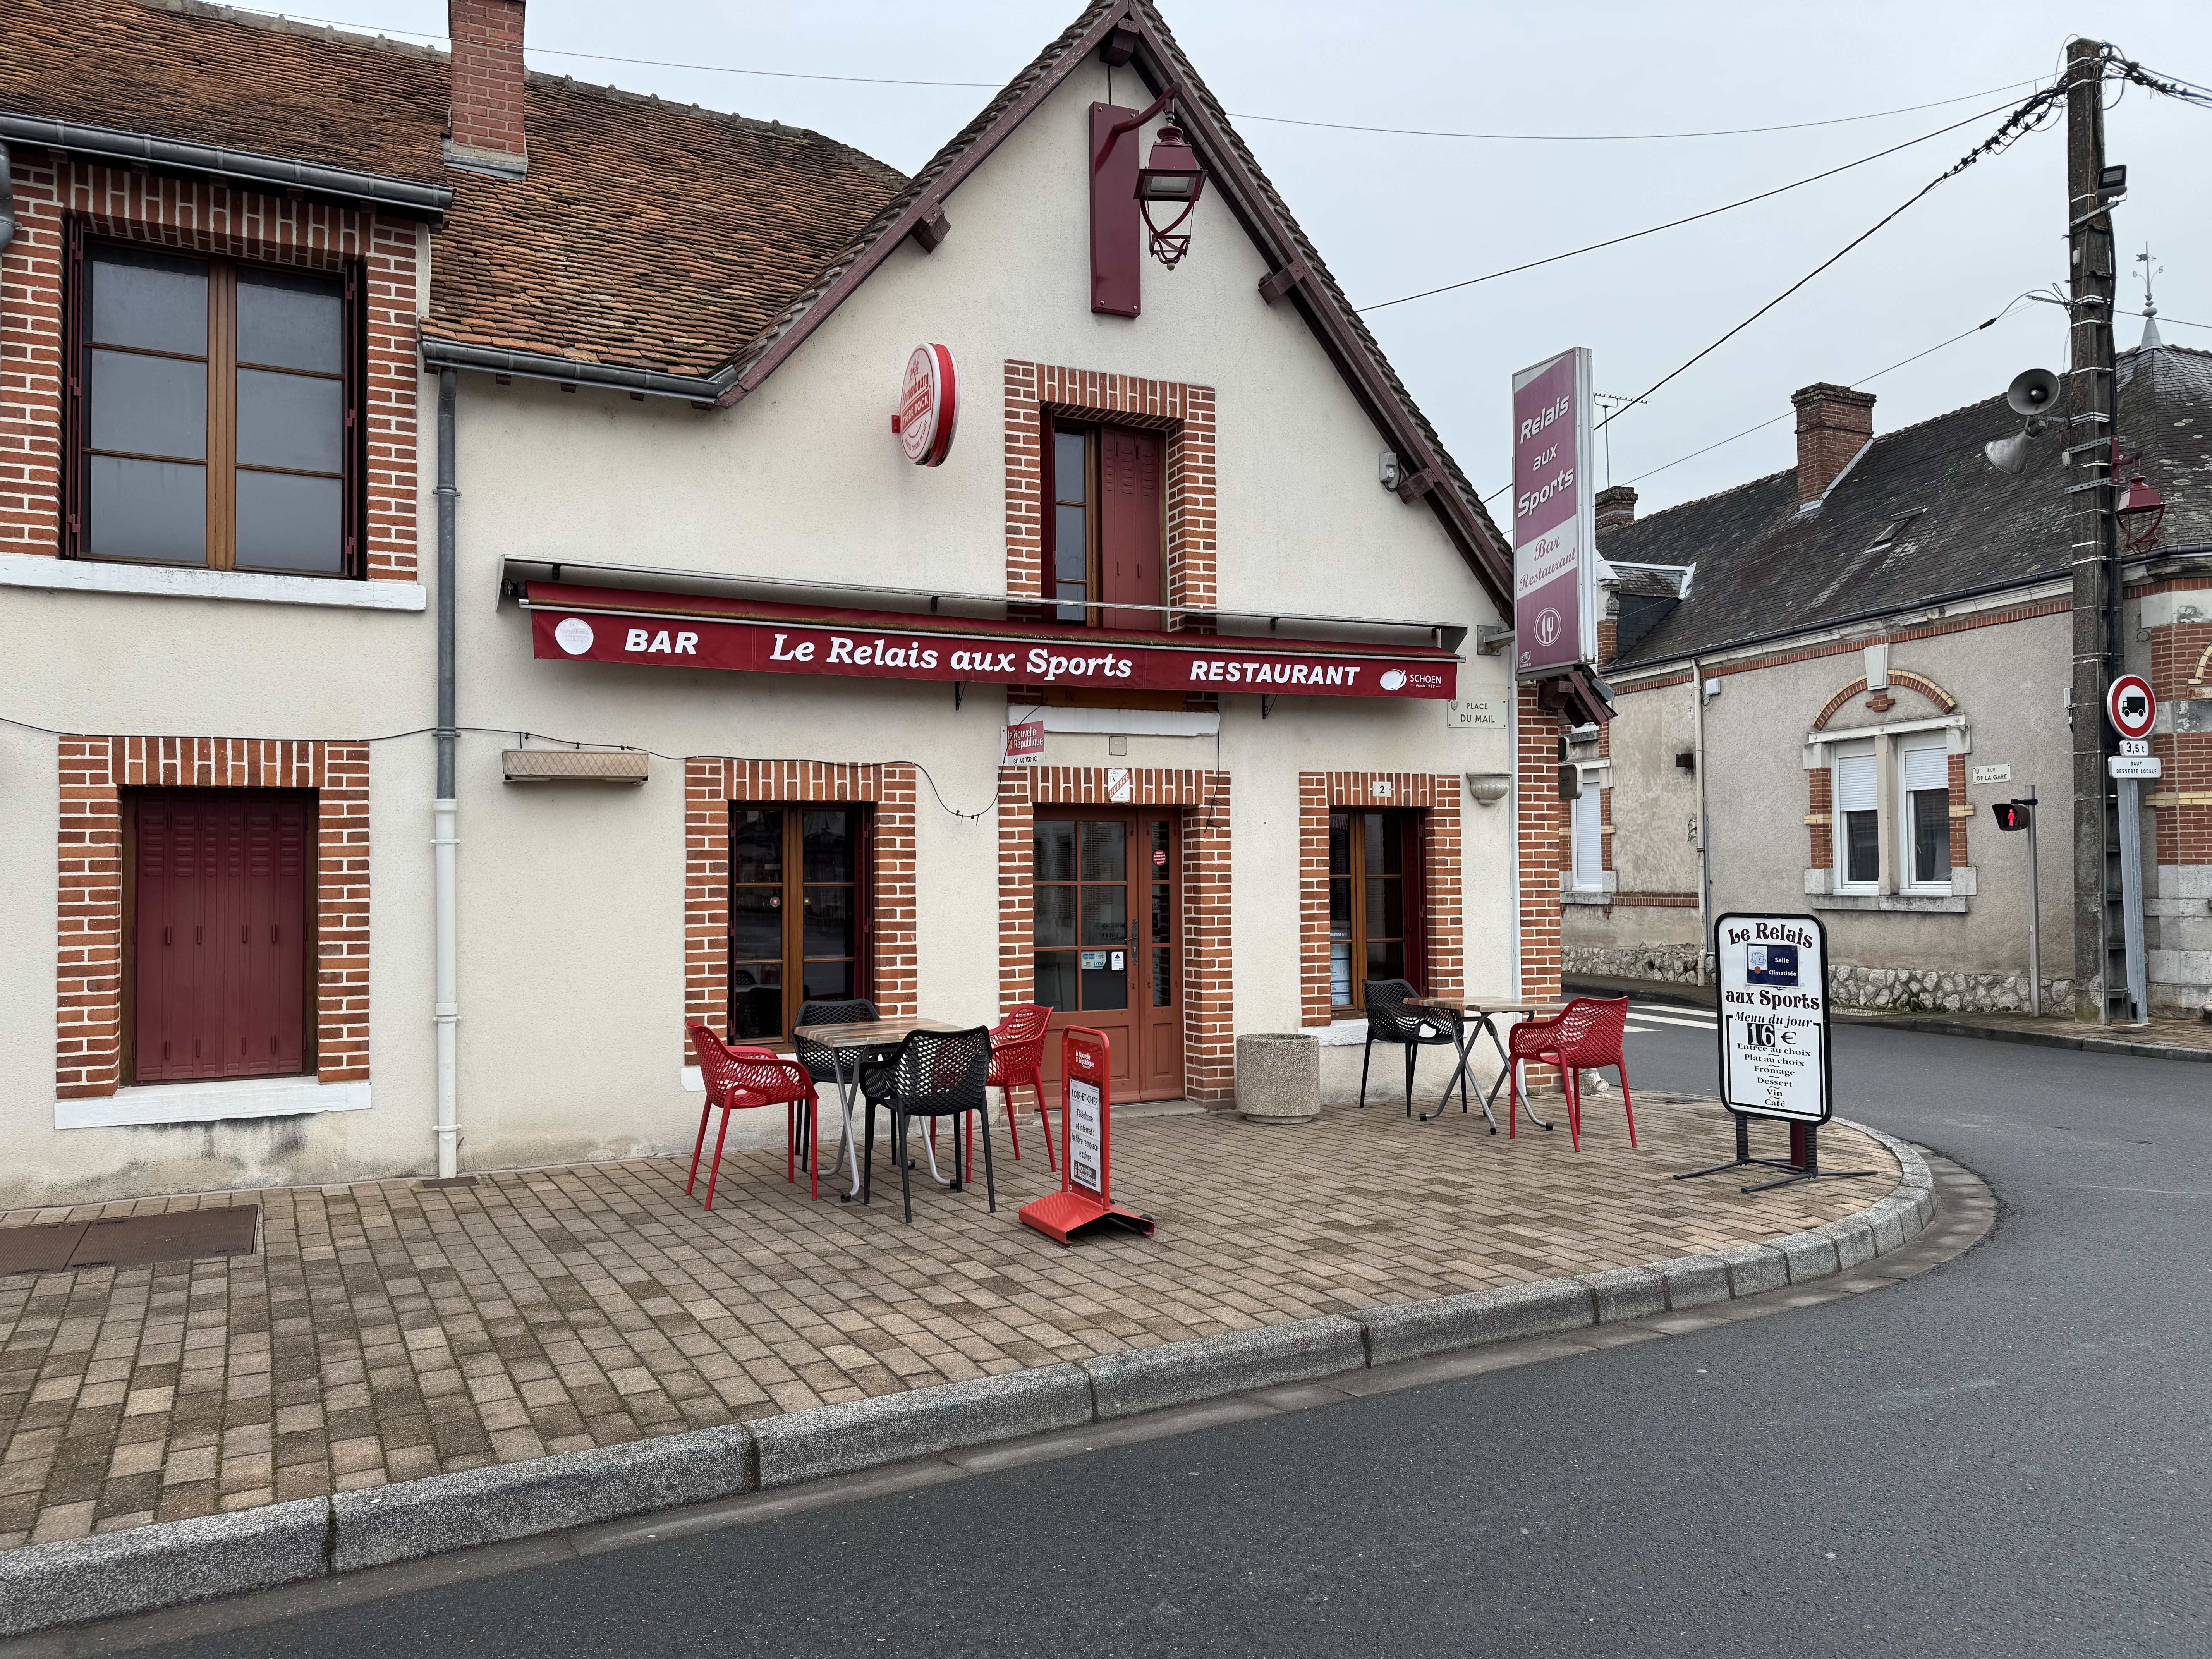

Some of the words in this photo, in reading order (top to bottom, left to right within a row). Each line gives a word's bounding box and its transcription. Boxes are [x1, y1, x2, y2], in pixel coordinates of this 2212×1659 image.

[902, 373, 929, 408] Kronenbourg
[903, 407, 914, 427] TIGRE
[914, 394, 928, 414] BOCK
[1520, 395, 1569, 444] Relais
[1533, 443, 1558, 471] aux
[1517, 467, 1574, 518] Sports
[1534, 536, 1560, 561] Bar
[1519, 546, 1576, 591] Restaurant
[625, 628, 698, 654] BAR
[770, 634, 815, 661] Le
[826, 637, 938, 670] Relais
[950, 651, 1015, 672] aux
[1027, 648, 1132, 681] Sports
[1190, 661, 1360, 685] RESTAURANT
[1410, 674, 1441, 684] SCHOEN
[1475, 715, 1495, 723] MAIL
[1013, 726, 1036, 739] Nouvelle
[1014, 737, 1043, 750] République
[2126, 742, 2139, 754] 3,5
[1109, 772, 1130, 797] LICENCE
[1379, 785, 1385, 794] 2
[1728, 928, 1750, 945] Le
[1755, 922, 1813, 948] Relais
[1726, 991, 1755, 1005] aux
[1759, 990, 1820, 1010] Sports
[1735, 1011, 1765, 1023] Menu
[1768, 1014, 1783, 1025] du
[1784, 1016, 1812, 1028] jour
[1750, 1024, 1775, 1046] 16
[1780, 1031, 1796, 1045] €
[1784, 1048, 1812, 1056] choix
[1754, 1065, 1795, 1077] Fromage
[1778, 1058, 1805, 1066] choix
[1757, 1077, 1792, 1087] Dessert
[1072, 1089, 1098, 1107] LOIR-ET-CHER
[1764, 1099, 1786, 1107] Café
[1076, 1108, 1093, 1123] Téléphone
[1080, 1123, 1093, 1136] Internet
[1072, 1132, 1075, 1141] la
[1083, 1139, 1098, 1152] remplace
[1078, 1148, 1082, 1157] le
[1082, 1151, 1091, 1162] cuivre
